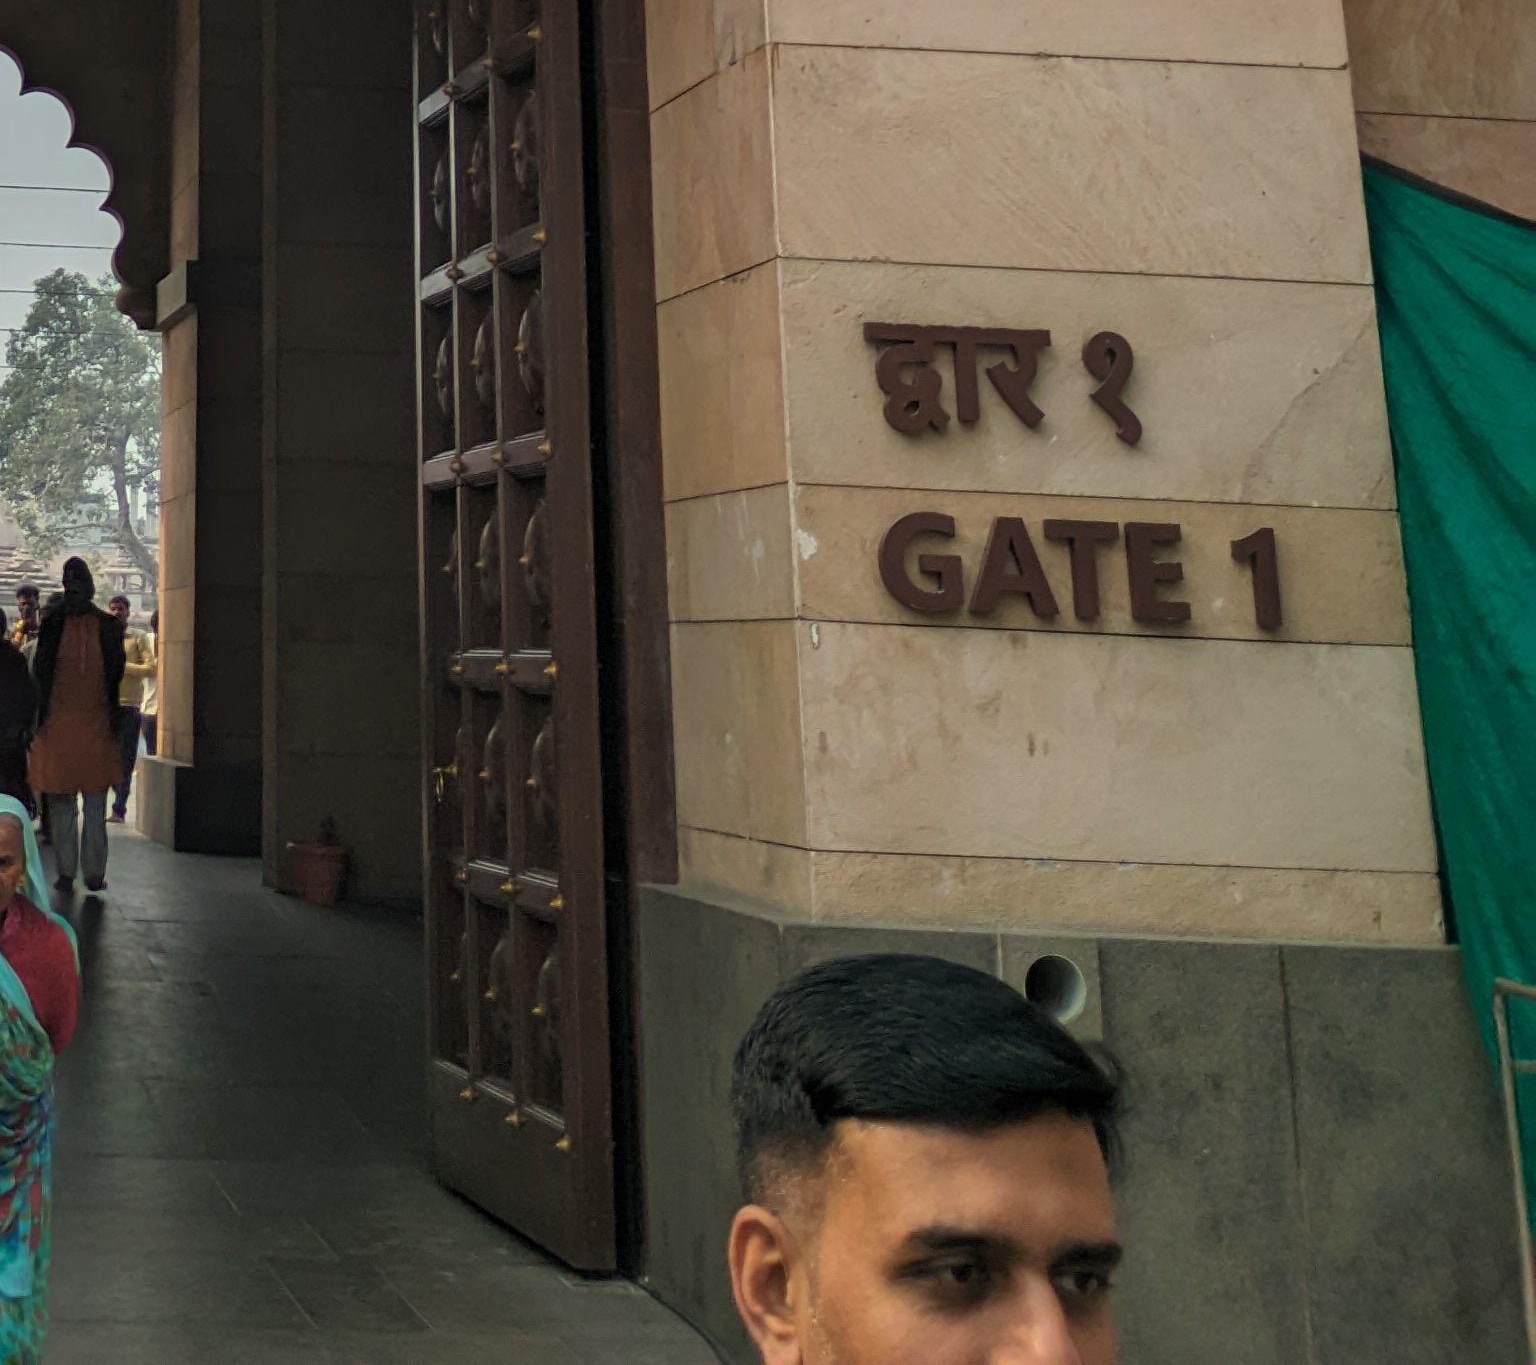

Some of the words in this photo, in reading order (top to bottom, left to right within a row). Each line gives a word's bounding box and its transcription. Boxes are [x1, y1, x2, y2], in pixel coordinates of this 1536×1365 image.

[865, 322, 1051, 435] द्वार
[1081, 330, 1143, 447] १
[877, 511, 1192, 624] GATE
[1230, 526, 1283, 633] 1
